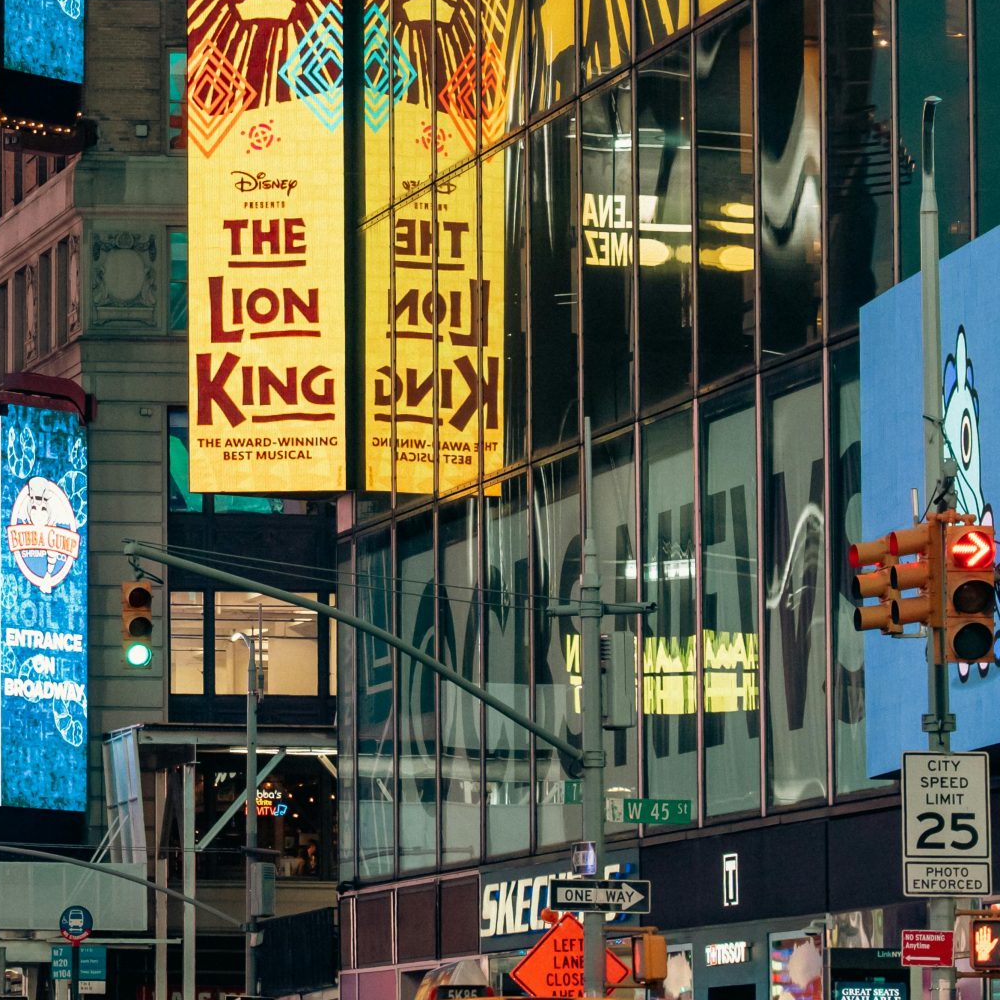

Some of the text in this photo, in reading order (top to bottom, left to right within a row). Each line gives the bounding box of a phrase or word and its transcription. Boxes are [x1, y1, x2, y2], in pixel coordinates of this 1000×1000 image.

[231, 170, 298, 197] Disney
[223, 218, 307, 255] THE
[208, 276, 319, 344] LION
[196, 352, 336, 428] KING
[198, 437, 338, 448] THE AWARD-WINNING
[223, 450, 313, 461] BEST MUSICAL
[10, 529, 77, 553] BUBBA GUMP
[5, 628, 83, 653] ENTRANCE
[32, 653, 55, 675] ON
[3, 677, 85, 702] BROADWAY
[928, 760, 960, 772] CITY
[920, 777, 969, 789] SPEED
[926, 794, 964, 805] LIMIT
[628, 802, 688, 820] W 45 St
[916, 811, 979, 851] 25
[926, 867, 969, 878] PHOTO
[912, 879, 983, 890] ENFORCED
[564, 888, 635, 903] ONE WAY
[905, 933, 946, 943] NO STANDING
[717, 941, 747, 965] TISSOT
[905, 942, 931, 951] Anytime
[877, 950, 901, 959] LinkNY
[546, 972, 584, 987] CLOSE
[841, 988, 900, 997] GREAT SEATS
